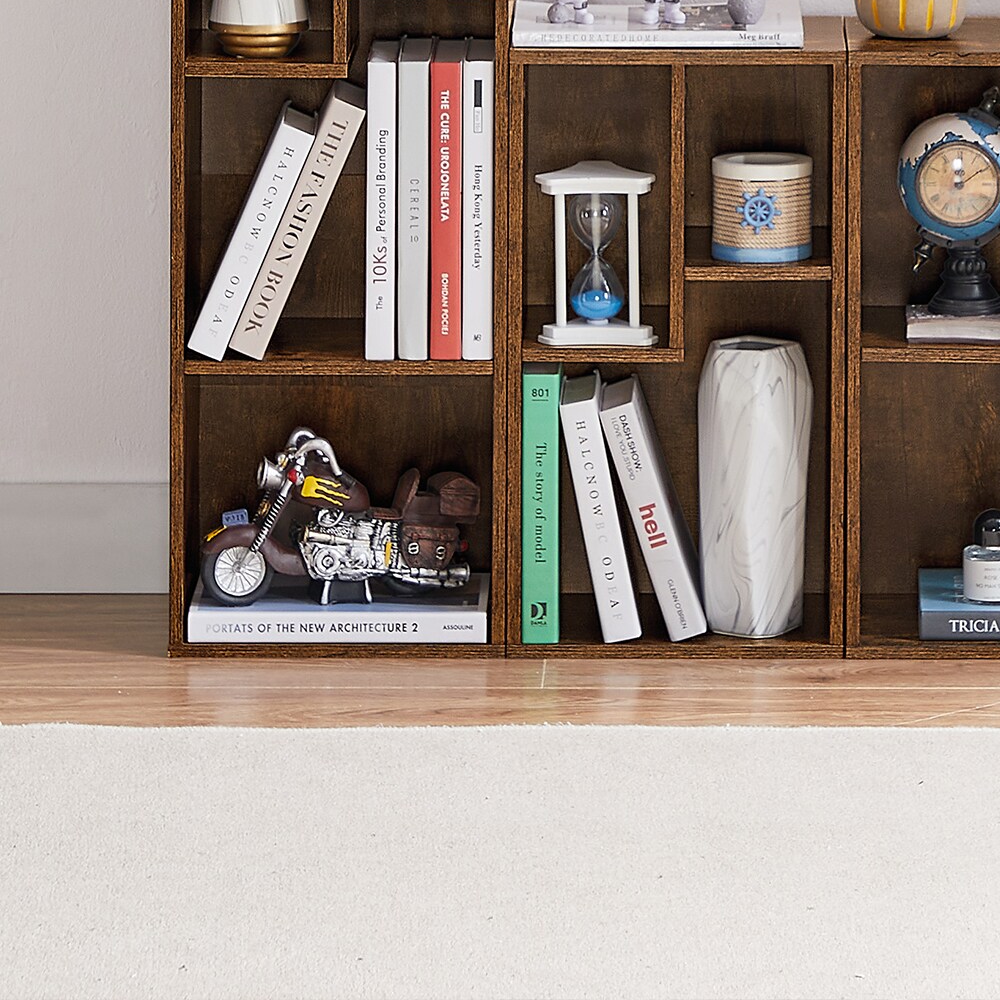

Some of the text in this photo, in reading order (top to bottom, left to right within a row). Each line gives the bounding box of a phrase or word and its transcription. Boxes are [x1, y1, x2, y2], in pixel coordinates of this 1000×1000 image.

[440, 89, 450, 110] THE
[317, 120, 349, 164] THE
[440, 112, 450, 144] CURE:
[375, 129, 389, 181] Branding
[376, 183, 386, 232] Personal
[409, 178, 420, 229] CEREAL
[471, 165, 483, 270] Hong Kong Yesterday
[372, 245, 387, 284] 10Ks
[244, 271, 283, 335] BOOK
[375, 295, 383, 310] The
[531, 388, 550, 398] 801
[618, 414, 633, 439] DASH
[532, 442, 547, 563] The story of model
[639, 502, 668, 549] hell
[205, 622, 419, 634] PORTATS OF THE NEW ARCHITECTURE 2
[949, 619, 999, 633] TRICIA
